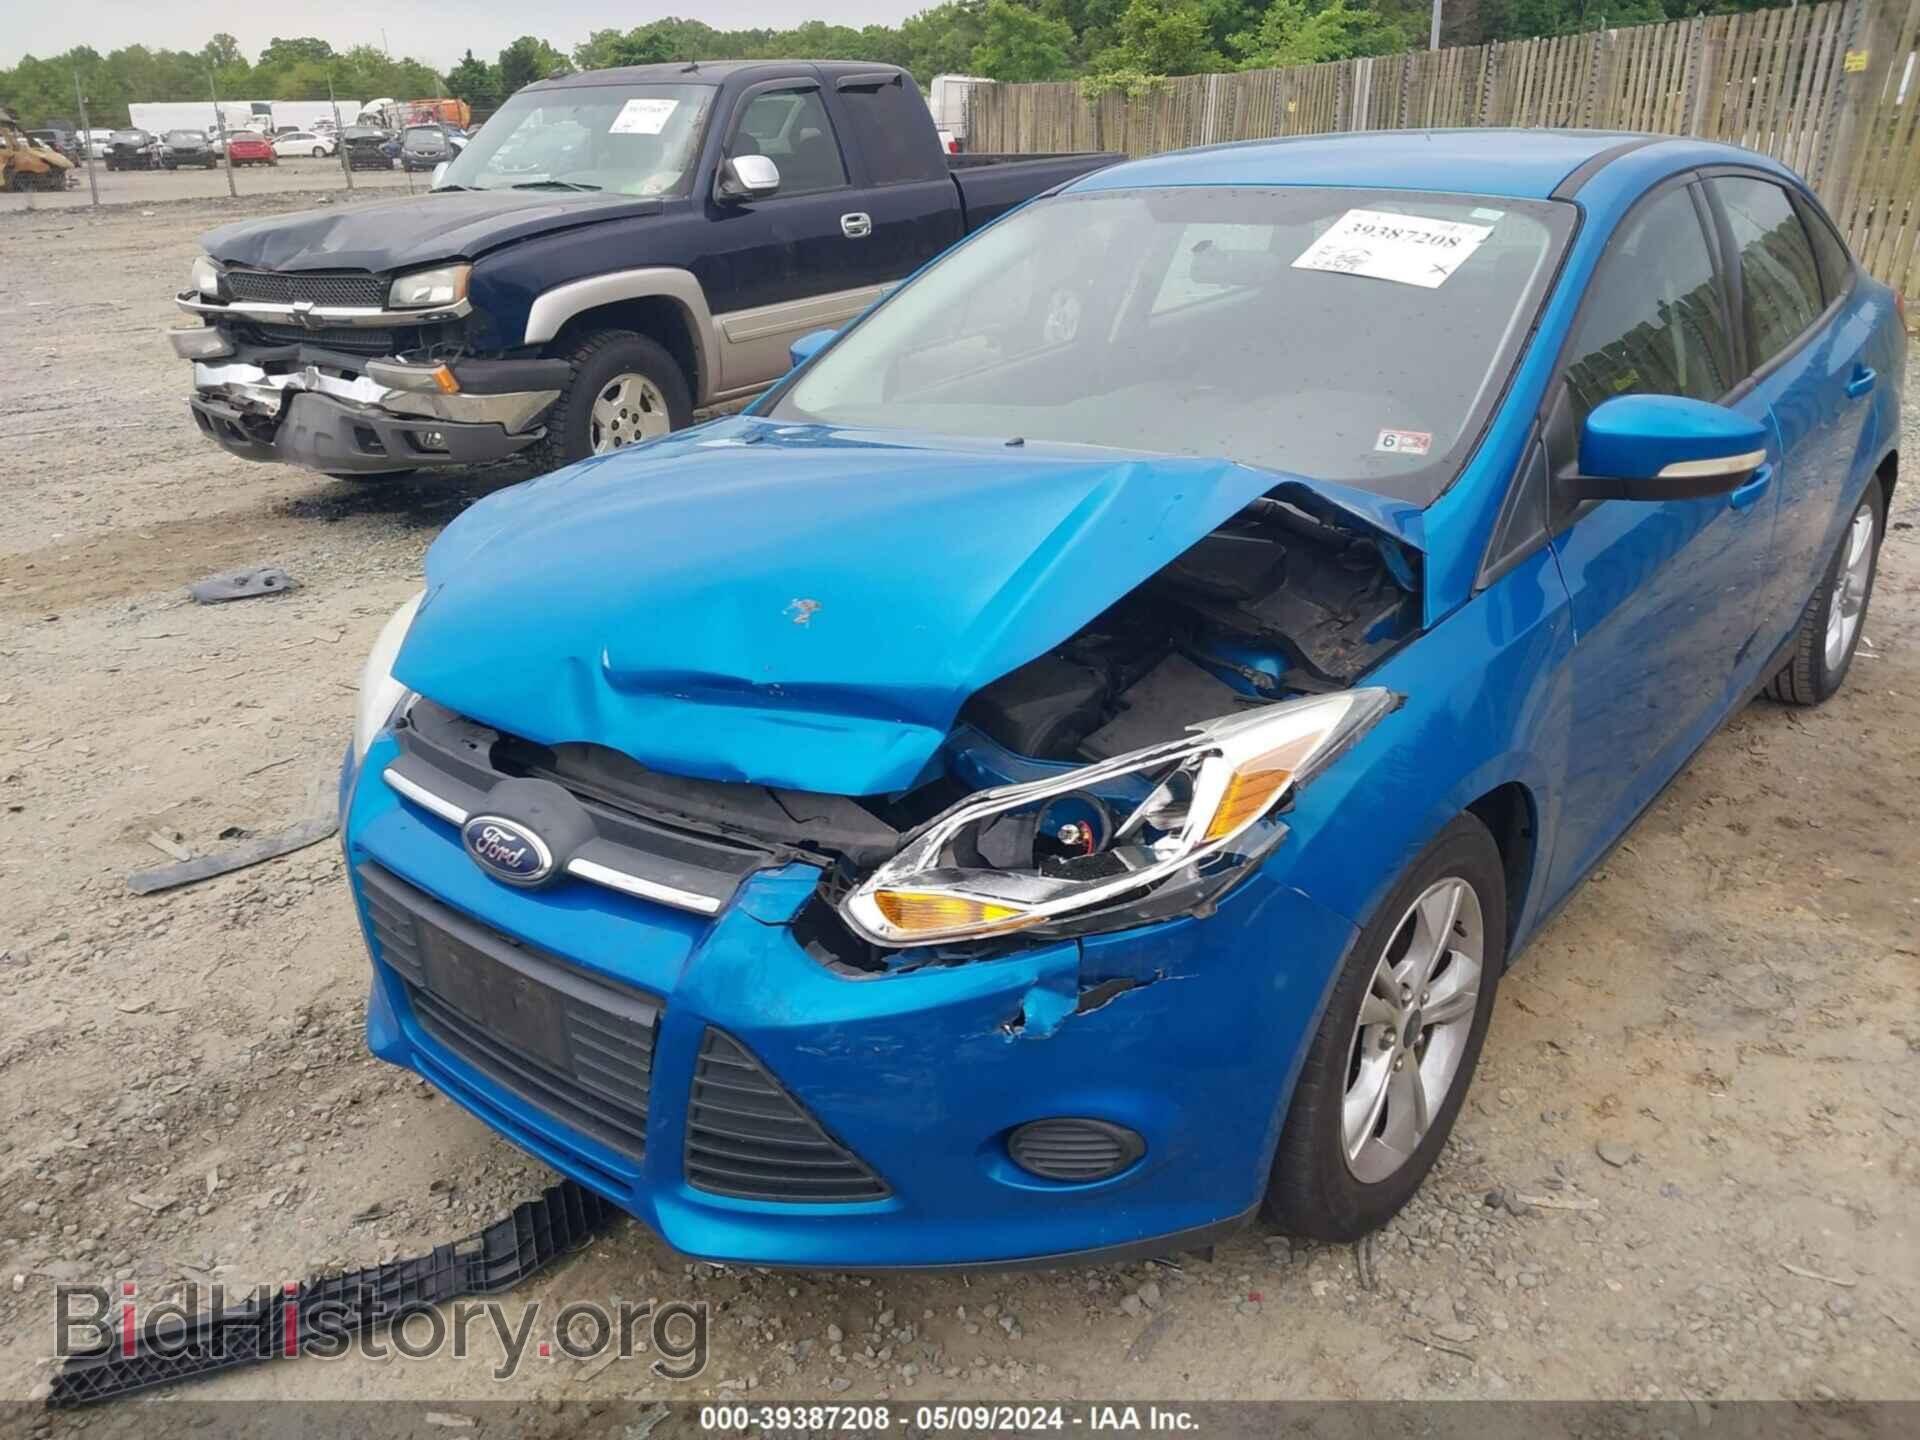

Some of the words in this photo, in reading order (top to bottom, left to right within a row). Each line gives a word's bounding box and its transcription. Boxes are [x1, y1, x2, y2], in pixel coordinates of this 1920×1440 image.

[1344, 222, 1462, 249] 39387208
[1383, 434, 1397, 447] 6
[476, 825, 527, 868] Ford
